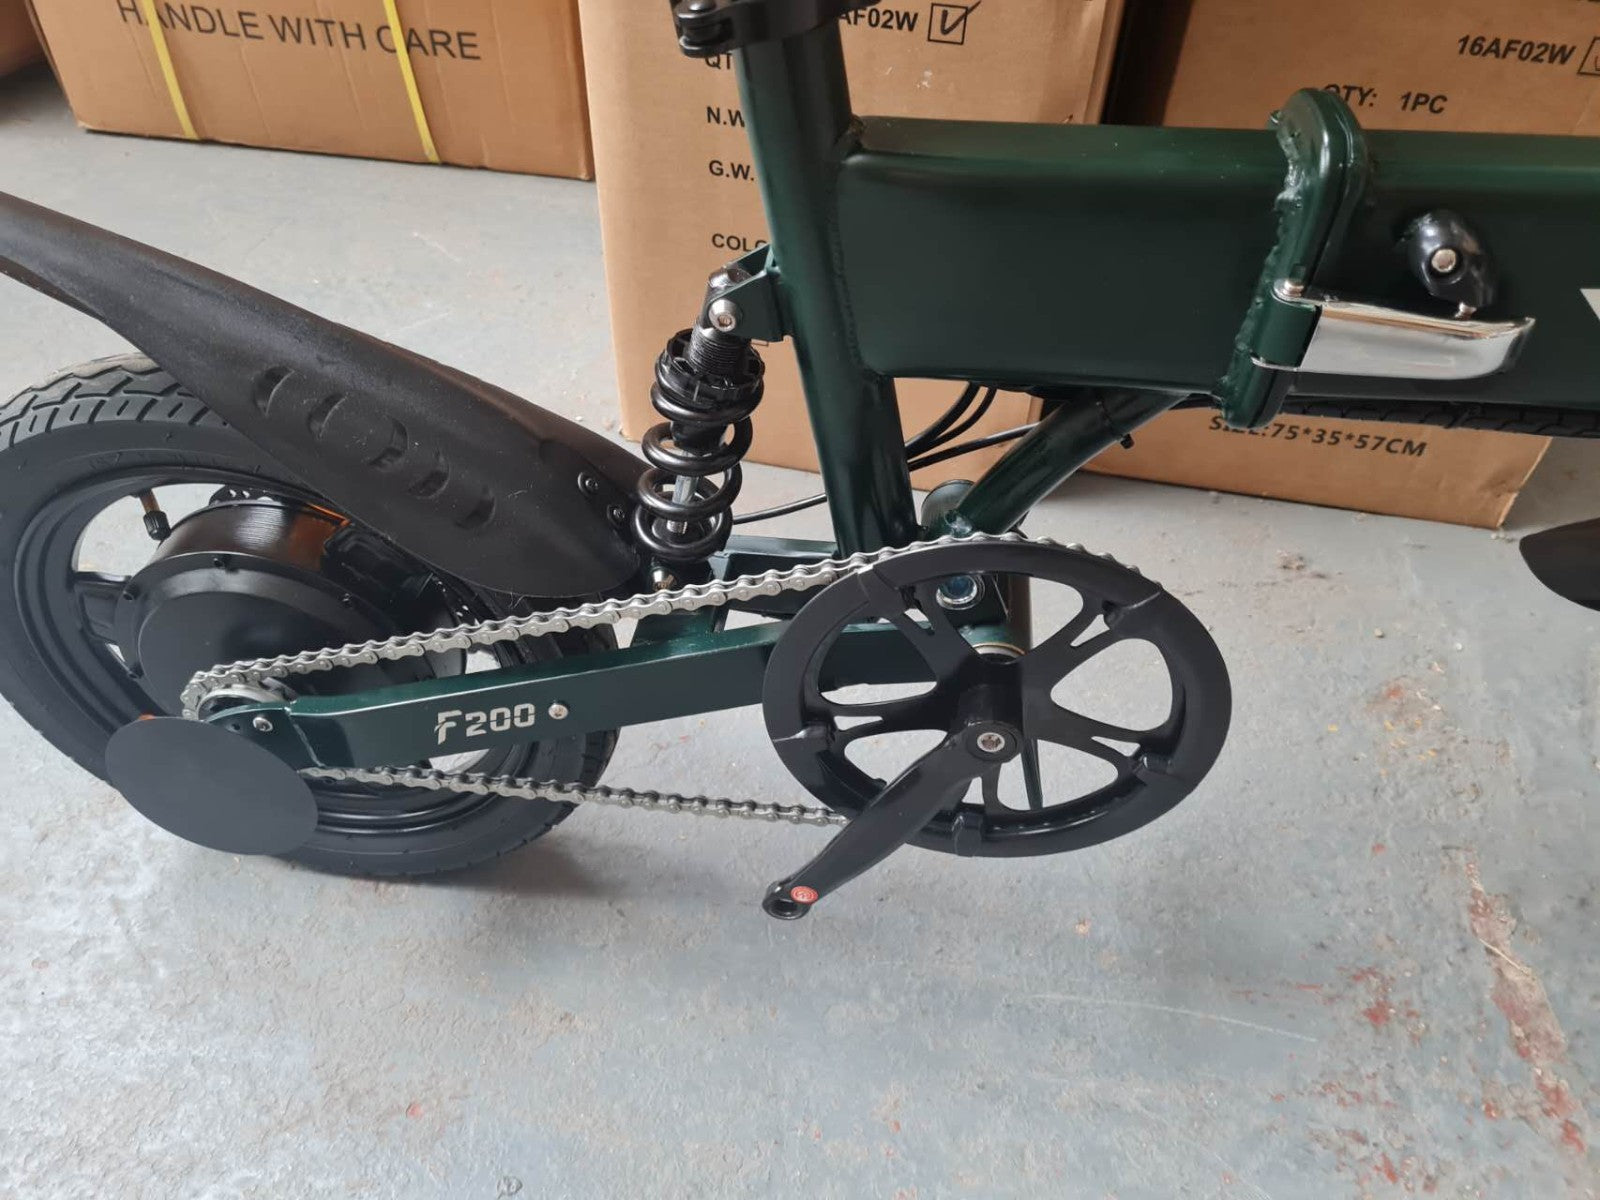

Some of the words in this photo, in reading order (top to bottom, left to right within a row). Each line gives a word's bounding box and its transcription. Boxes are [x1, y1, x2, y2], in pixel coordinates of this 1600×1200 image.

[268, 14, 366, 50] WITH
[376, 25, 481, 60] CARE
[1458, 34, 1577, 65] 16AF02W
[1401, 91, 1448, 114] 1PC
[709, 160, 754, 181] G.W.
[434, 703, 536, 745] F200
